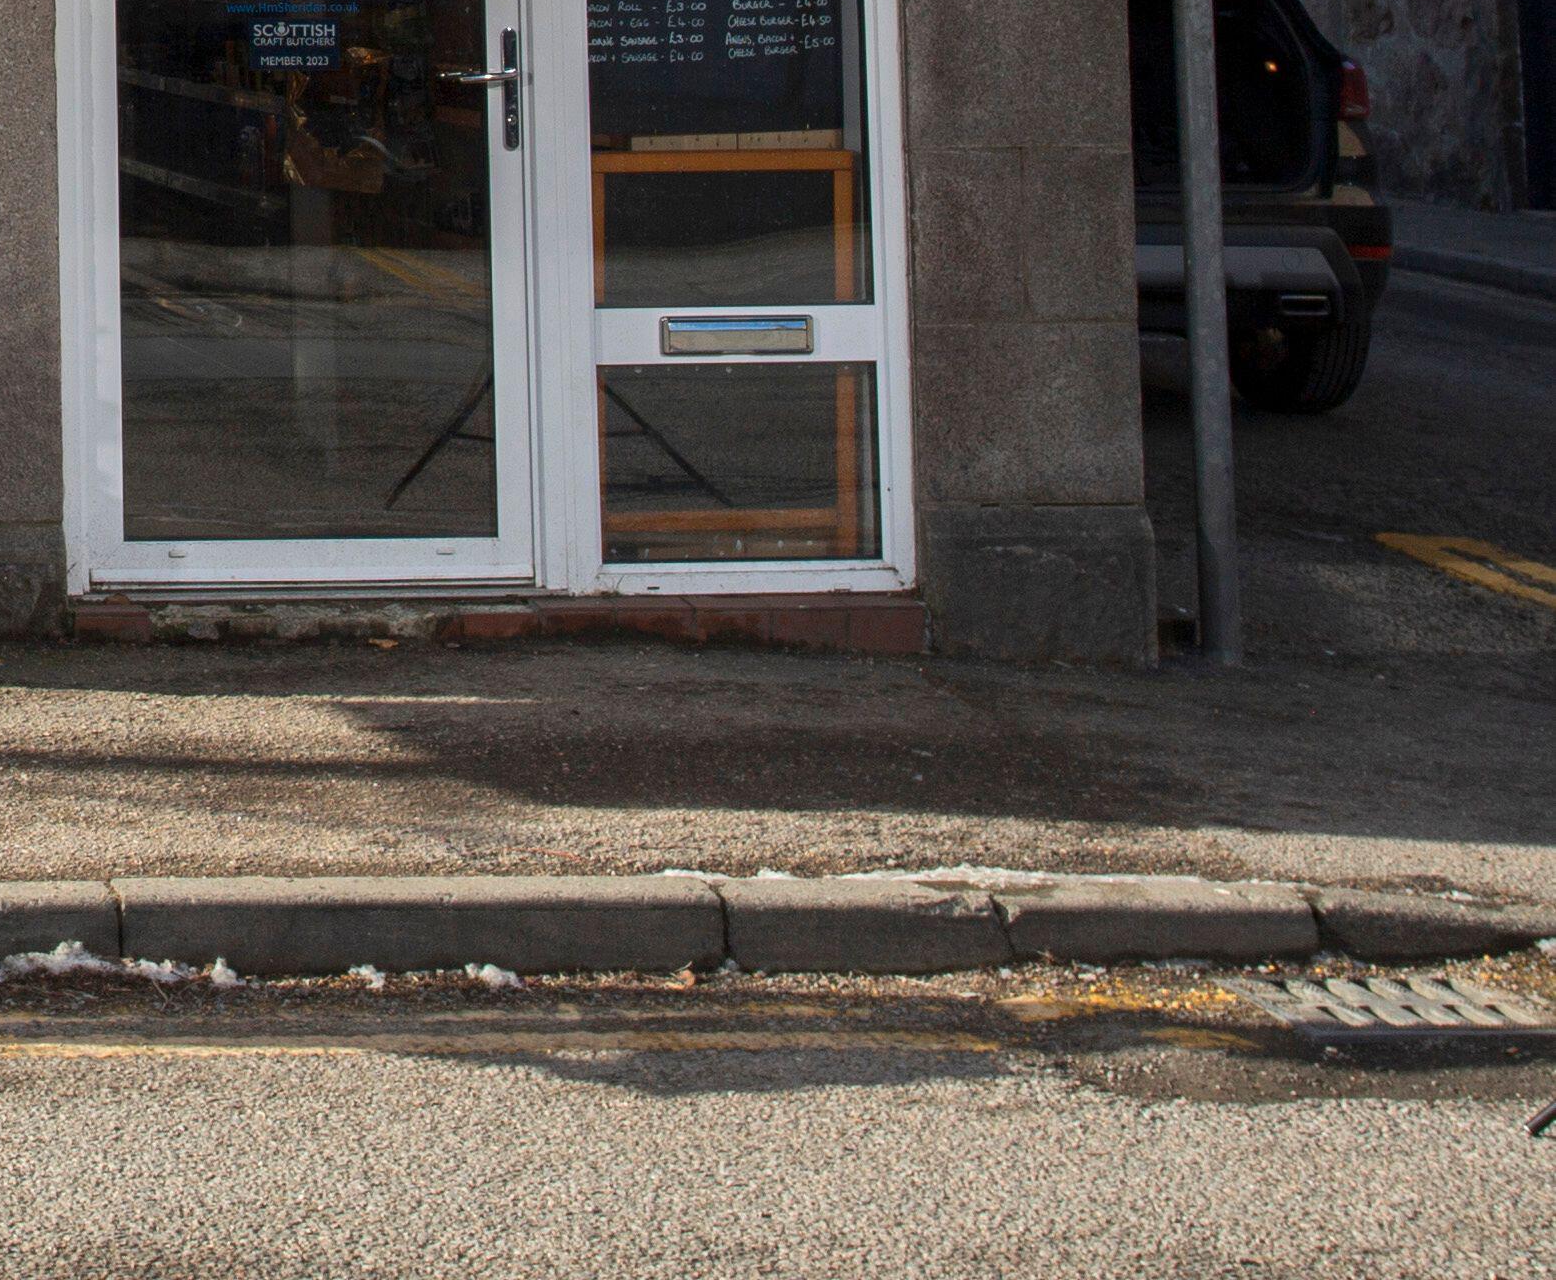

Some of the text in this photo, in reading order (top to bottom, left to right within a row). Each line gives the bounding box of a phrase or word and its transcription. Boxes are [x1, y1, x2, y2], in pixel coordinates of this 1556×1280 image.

[732, 0, 773, 10] BURGER
[253, 21, 336, 37] SCOTTISH
[253, 38, 336, 47] CRAFT BUTCHERS
[260, 56, 303, 65] MEMBER
